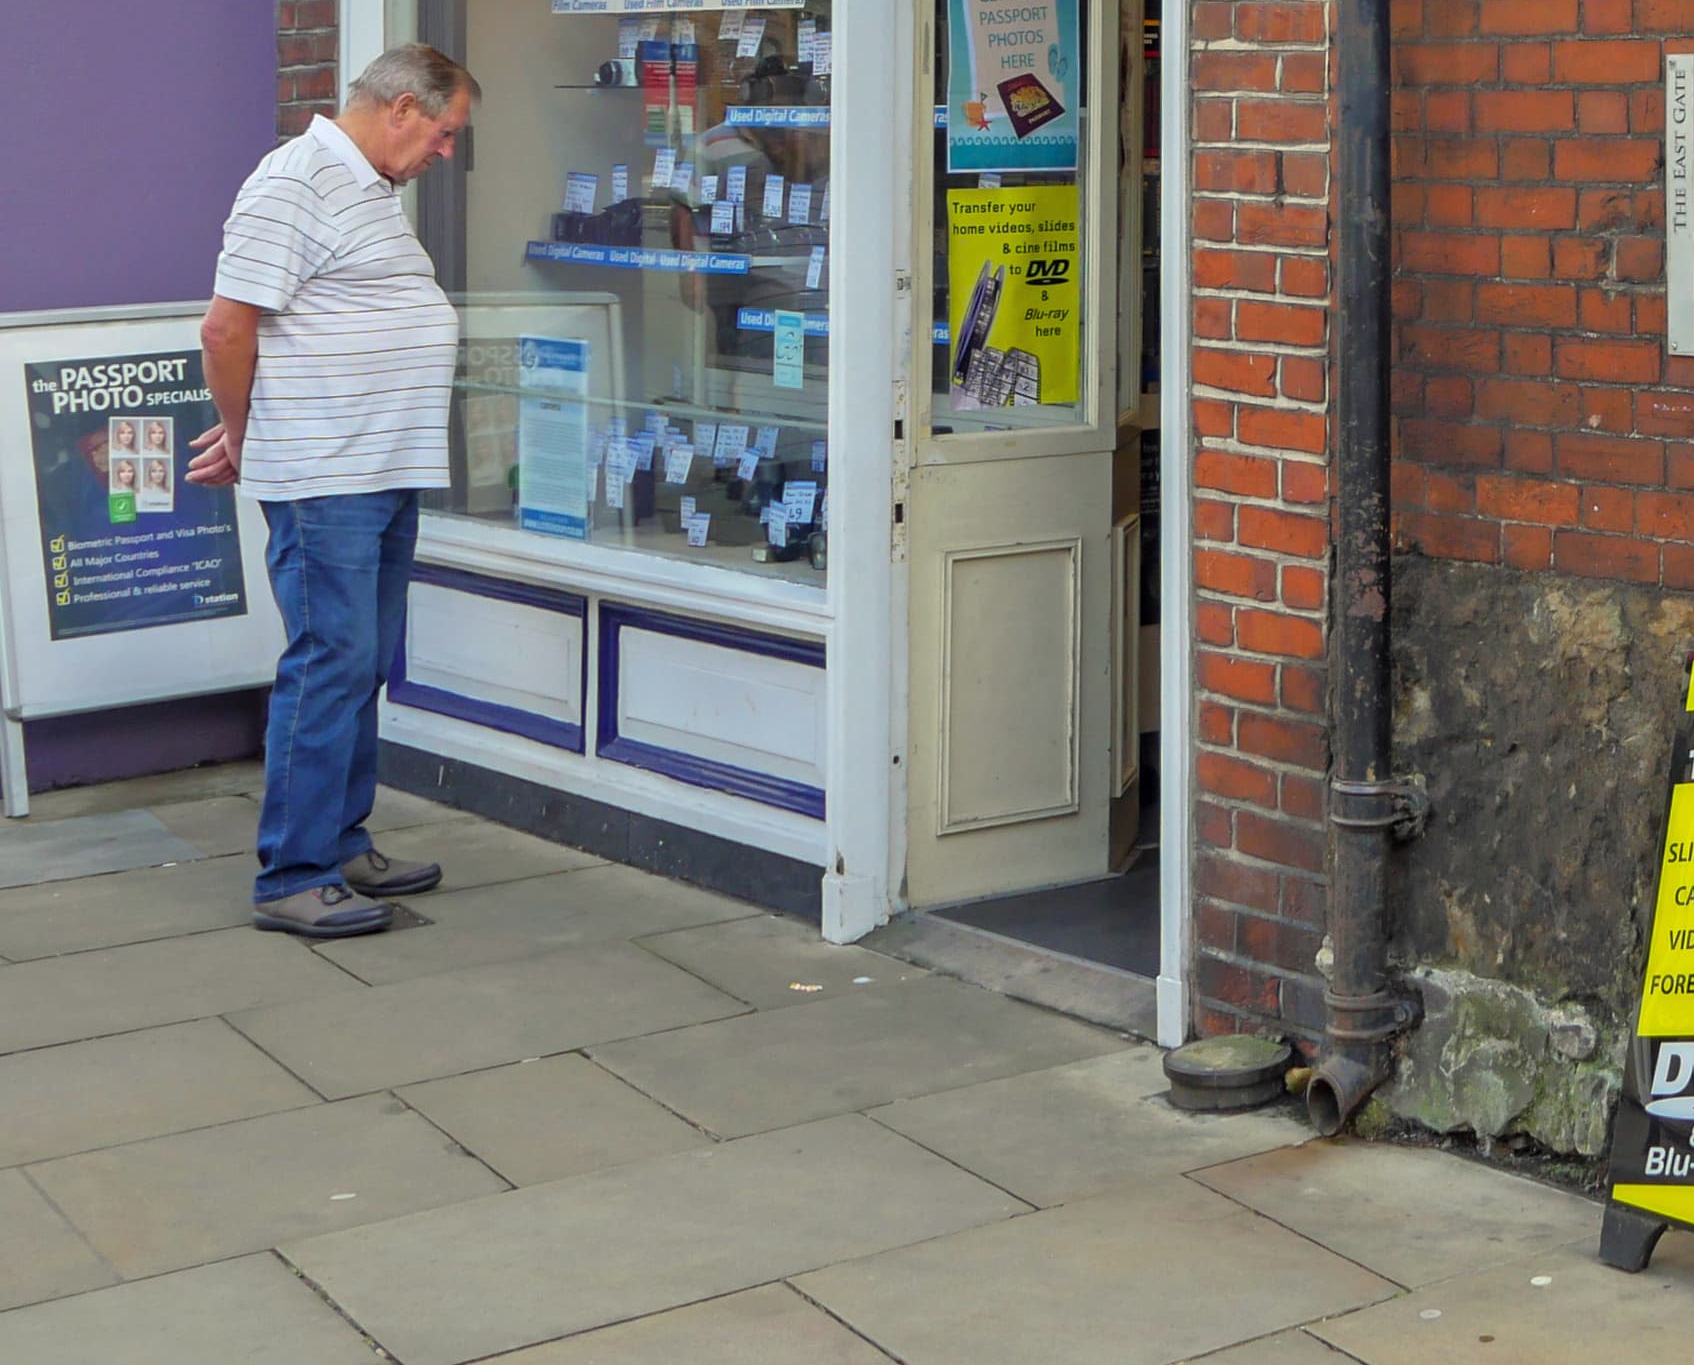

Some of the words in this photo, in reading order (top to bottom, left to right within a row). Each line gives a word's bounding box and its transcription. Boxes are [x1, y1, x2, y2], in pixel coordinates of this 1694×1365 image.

[554, 0, 570, 11] Film
[572, 0, 607, 10] Cameras
[980, 7, 1048, 25] PASSPORT
[988, 30, 1044, 48] PHOTOS
[1001, 53, 1035, 69] HERE
[1672, 69, 1686, 124] GATE
[730, 110, 753, 123] Used
[755, 110, 787, 125] Digital
[789, 110, 831, 123] Cameras
[1673, 134, 1687, 180] EAST
[952, 202, 1004, 213] Transfer
[1009, 203, 1036, 215] your
[1673, 187, 1687, 234] THE
[953, 223, 984, 235] home
[989, 222, 1035, 234] videos,
[1038, 220, 1075, 232] slides
[573, 247, 604, 261] Cameras
[610, 250, 628, 262] Used
[1002, 243, 1011, 254] &
[1016, 243, 1040, 253] cine
[1043, 241, 1075, 252] films
[660, 254, 682, 267] Used
[682, 255, 708, 272] Digital
[709, 257, 745, 270] Cameras
[1010, 265, 1022, 275] to
[1025, 259, 1070, 278] DVD
[741, 313, 763, 325] Used
[1025, 308, 1069, 321] Blu-ray
[1036, 326, 1061, 337] here
[32, 379, 57, 393] the
[61, 359, 187, 390] PASSPORT
[53, 385, 143, 414] PHOTO
[146, 389, 212, 406] SPECIALIS
[68, 536, 112, 551] Biometric
[115, 532, 154, 546] Passport
[157, 529, 174, 540] and
[176, 528, 195, 539] Visa
[70, 558, 82, 568] All
[85, 555, 112, 567] Major
[115, 550, 159, 563] Countries
[73, 569, 134, 585] International
[136, 563, 190, 578] Compliance
[74, 587, 131, 603] Professional
[133, 586, 143, 596] &
[144, 581, 178, 594] reliable
[180, 578, 211, 591] service
